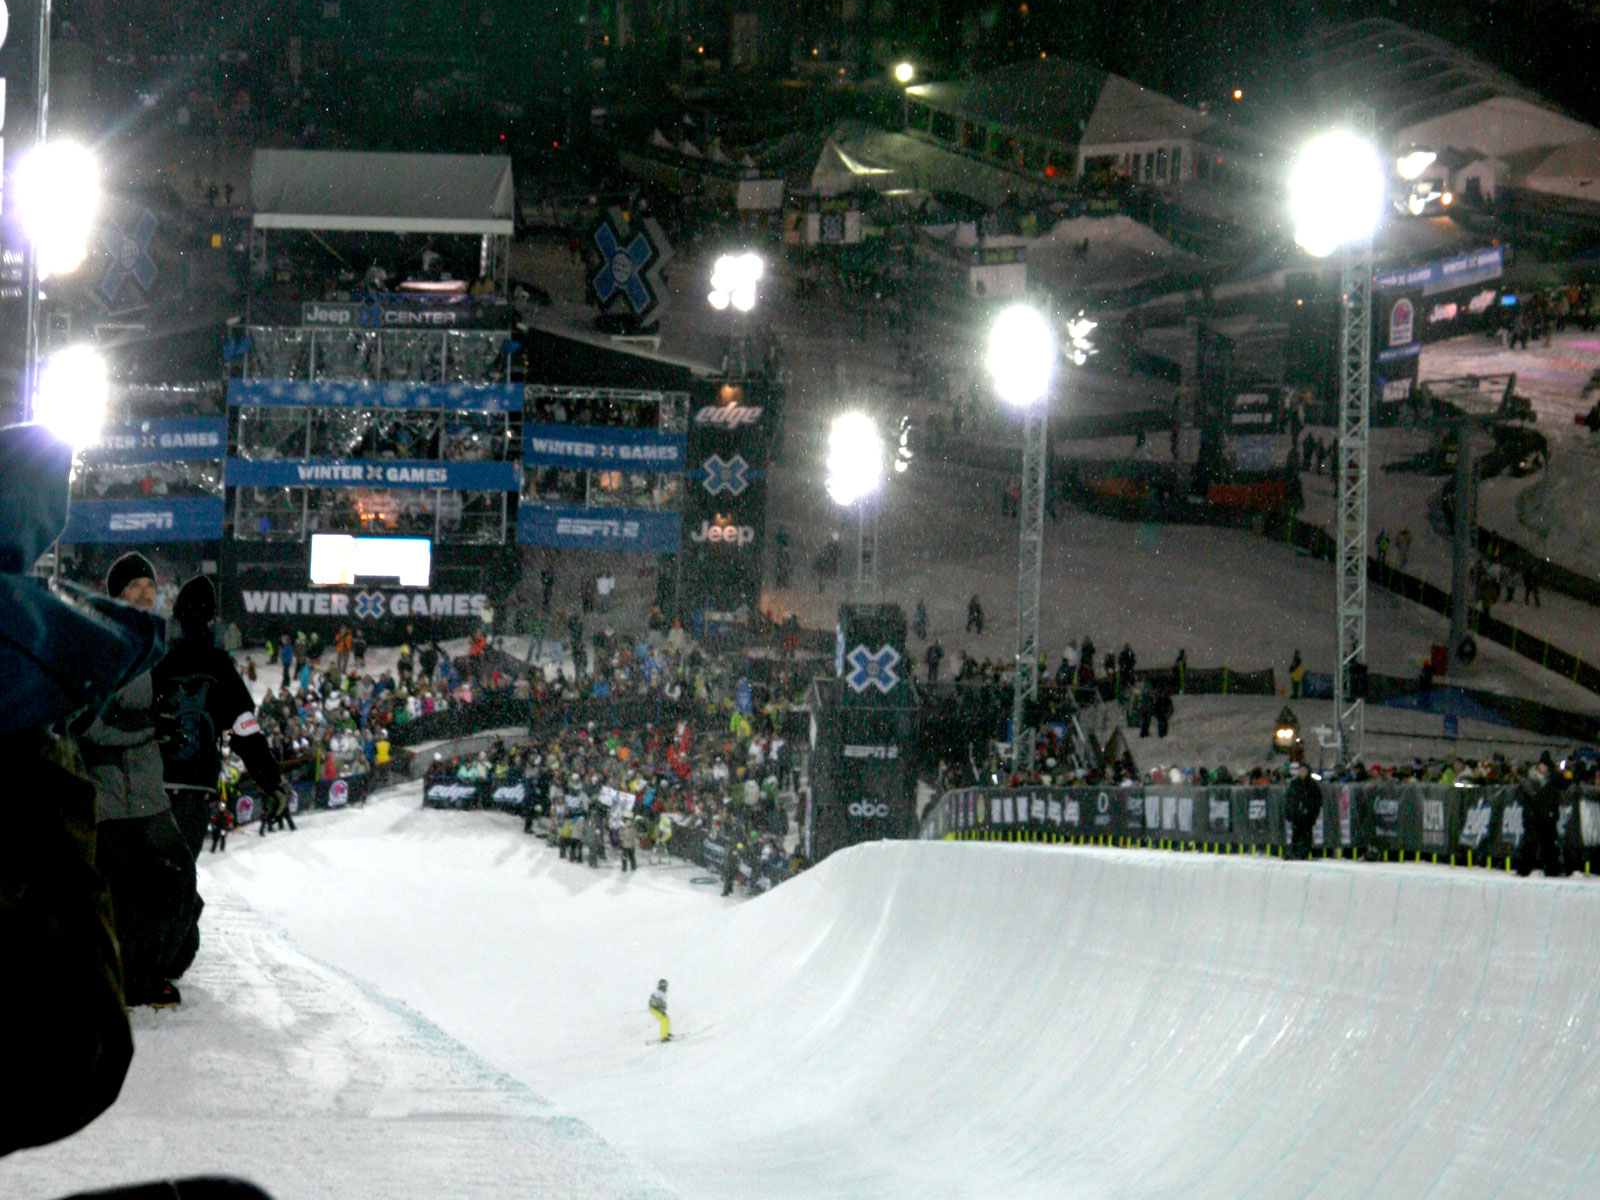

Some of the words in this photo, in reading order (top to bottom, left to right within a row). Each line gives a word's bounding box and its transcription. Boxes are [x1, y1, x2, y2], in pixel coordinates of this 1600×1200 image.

[306, 306, 350, 325] Jeep
[384, 310, 456, 325] CENTER
[694, 401, 763, 429] edge
[160, 431, 219, 449] GAMES
[532, 437, 595, 458] WINTER
[619, 445, 679, 460] GAMES
[297, 465, 363, 481] WINTER
[386, 467, 448, 483] GAMES
[109, 512, 174, 532] ESPN
[690, 520, 755, 546] Jeep
[242, 591, 349, 616] WINTER
[389, 594, 488, 617] GAMES
[848, 800, 889, 817] abc
